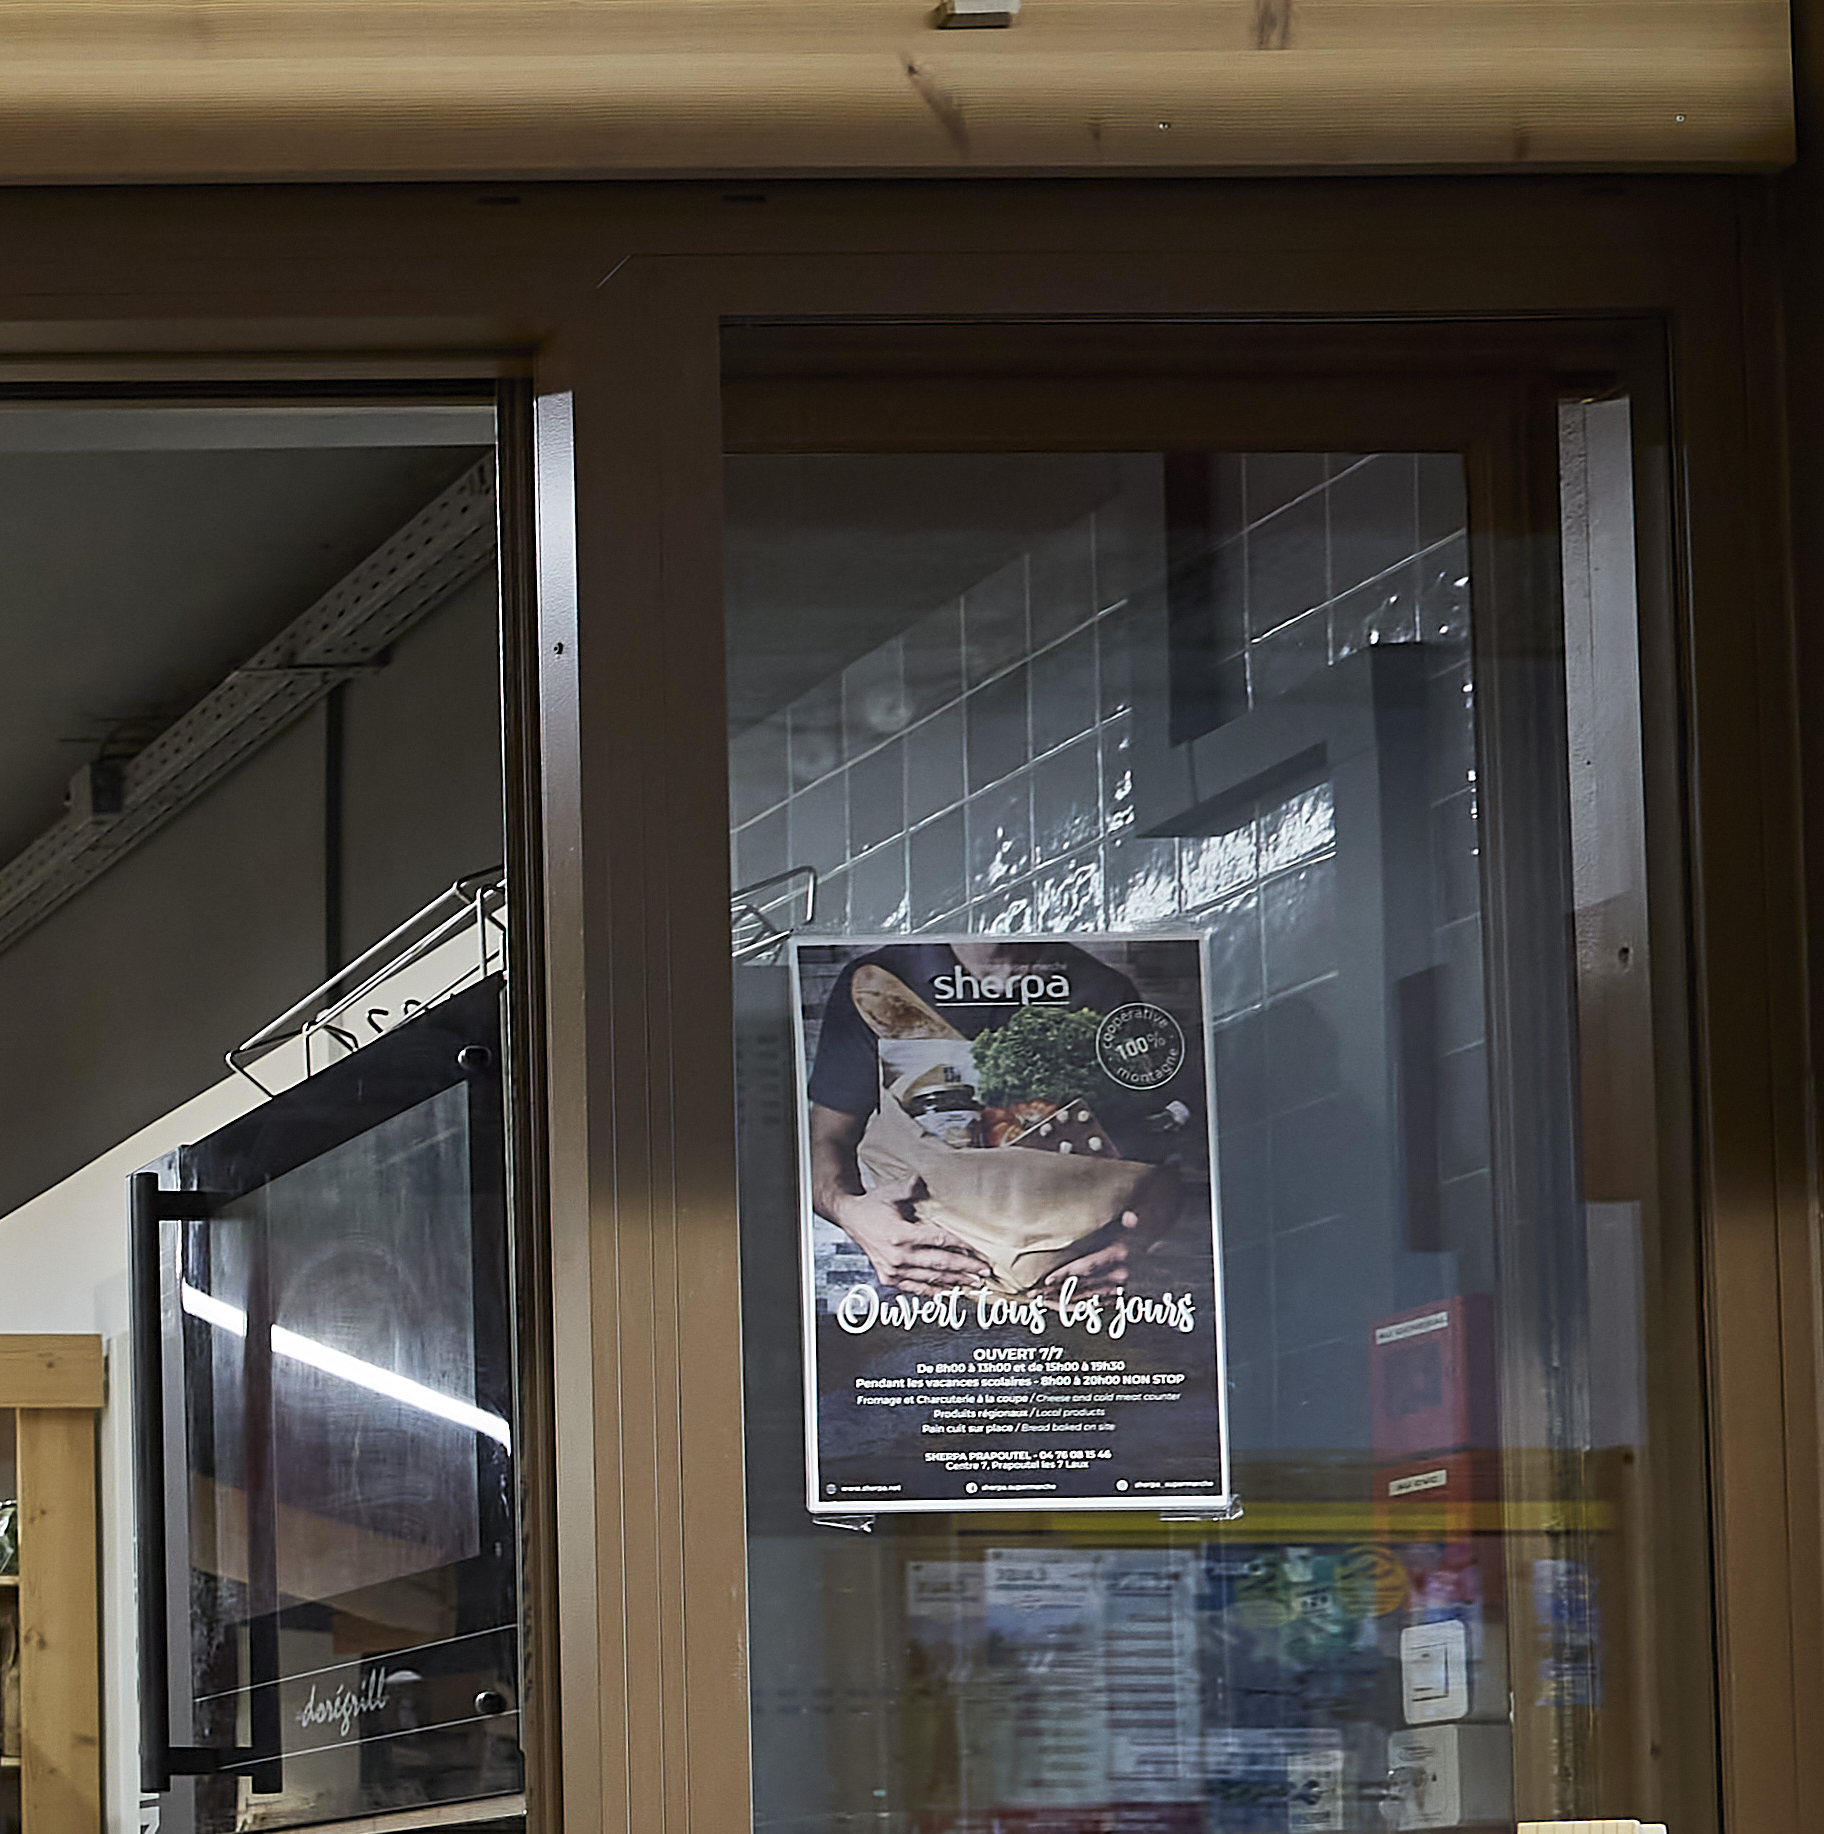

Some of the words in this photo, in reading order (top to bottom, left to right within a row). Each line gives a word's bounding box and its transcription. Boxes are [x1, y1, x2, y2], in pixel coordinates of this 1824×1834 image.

[933, 965, 1069, 1006] sherpa
[1115, 1031, 1166, 1060] 100%
[1117, 1048, 1179, 1084] montagne
[837, 1283, 967, 1334] Ouvert
[969, 1286, 1048, 1334] tous
[1060, 1275, 1104, 1333] les
[1108, 1288, 1196, 1339] jours
[973, 1348, 1037, 1361] OUVERT
[1039, 1346, 1064, 1361] 7/7
[917, 1364, 934, 1374] De
[978, 1363, 1012, 1373] 13h00
[1013, 1363, 1026, 1372] et
[1028, 1362, 1044, 1372] de
[855, 1378, 905, 1389] Pendant
[907, 1378, 924, 1388] les
[925, 1379, 979, 1388] vacances
[981, 1376, 1032, 1387] scolaires
[1083, 1375, 1121, 1386] 20h00
[1122, 1375, 1151, 1385] NON
[1152, 1374, 1185, 1385] STOP
[856, 1396, 902, 1407] Fromage
[916, 1394, 975, 1404] Charcuterie
[934, 1410, 976, 1419] Produits
[1036, 1408, 1062, 1417] Local
[1063, 1409, 1106, 1418] products
[922, 1424, 945, 1433] Pain
[985, 1424, 1014, 1434] place
[924, 1452, 967, 1462] SHERPA
[968, 1451, 1032, 1461] PRAPOUTEL
